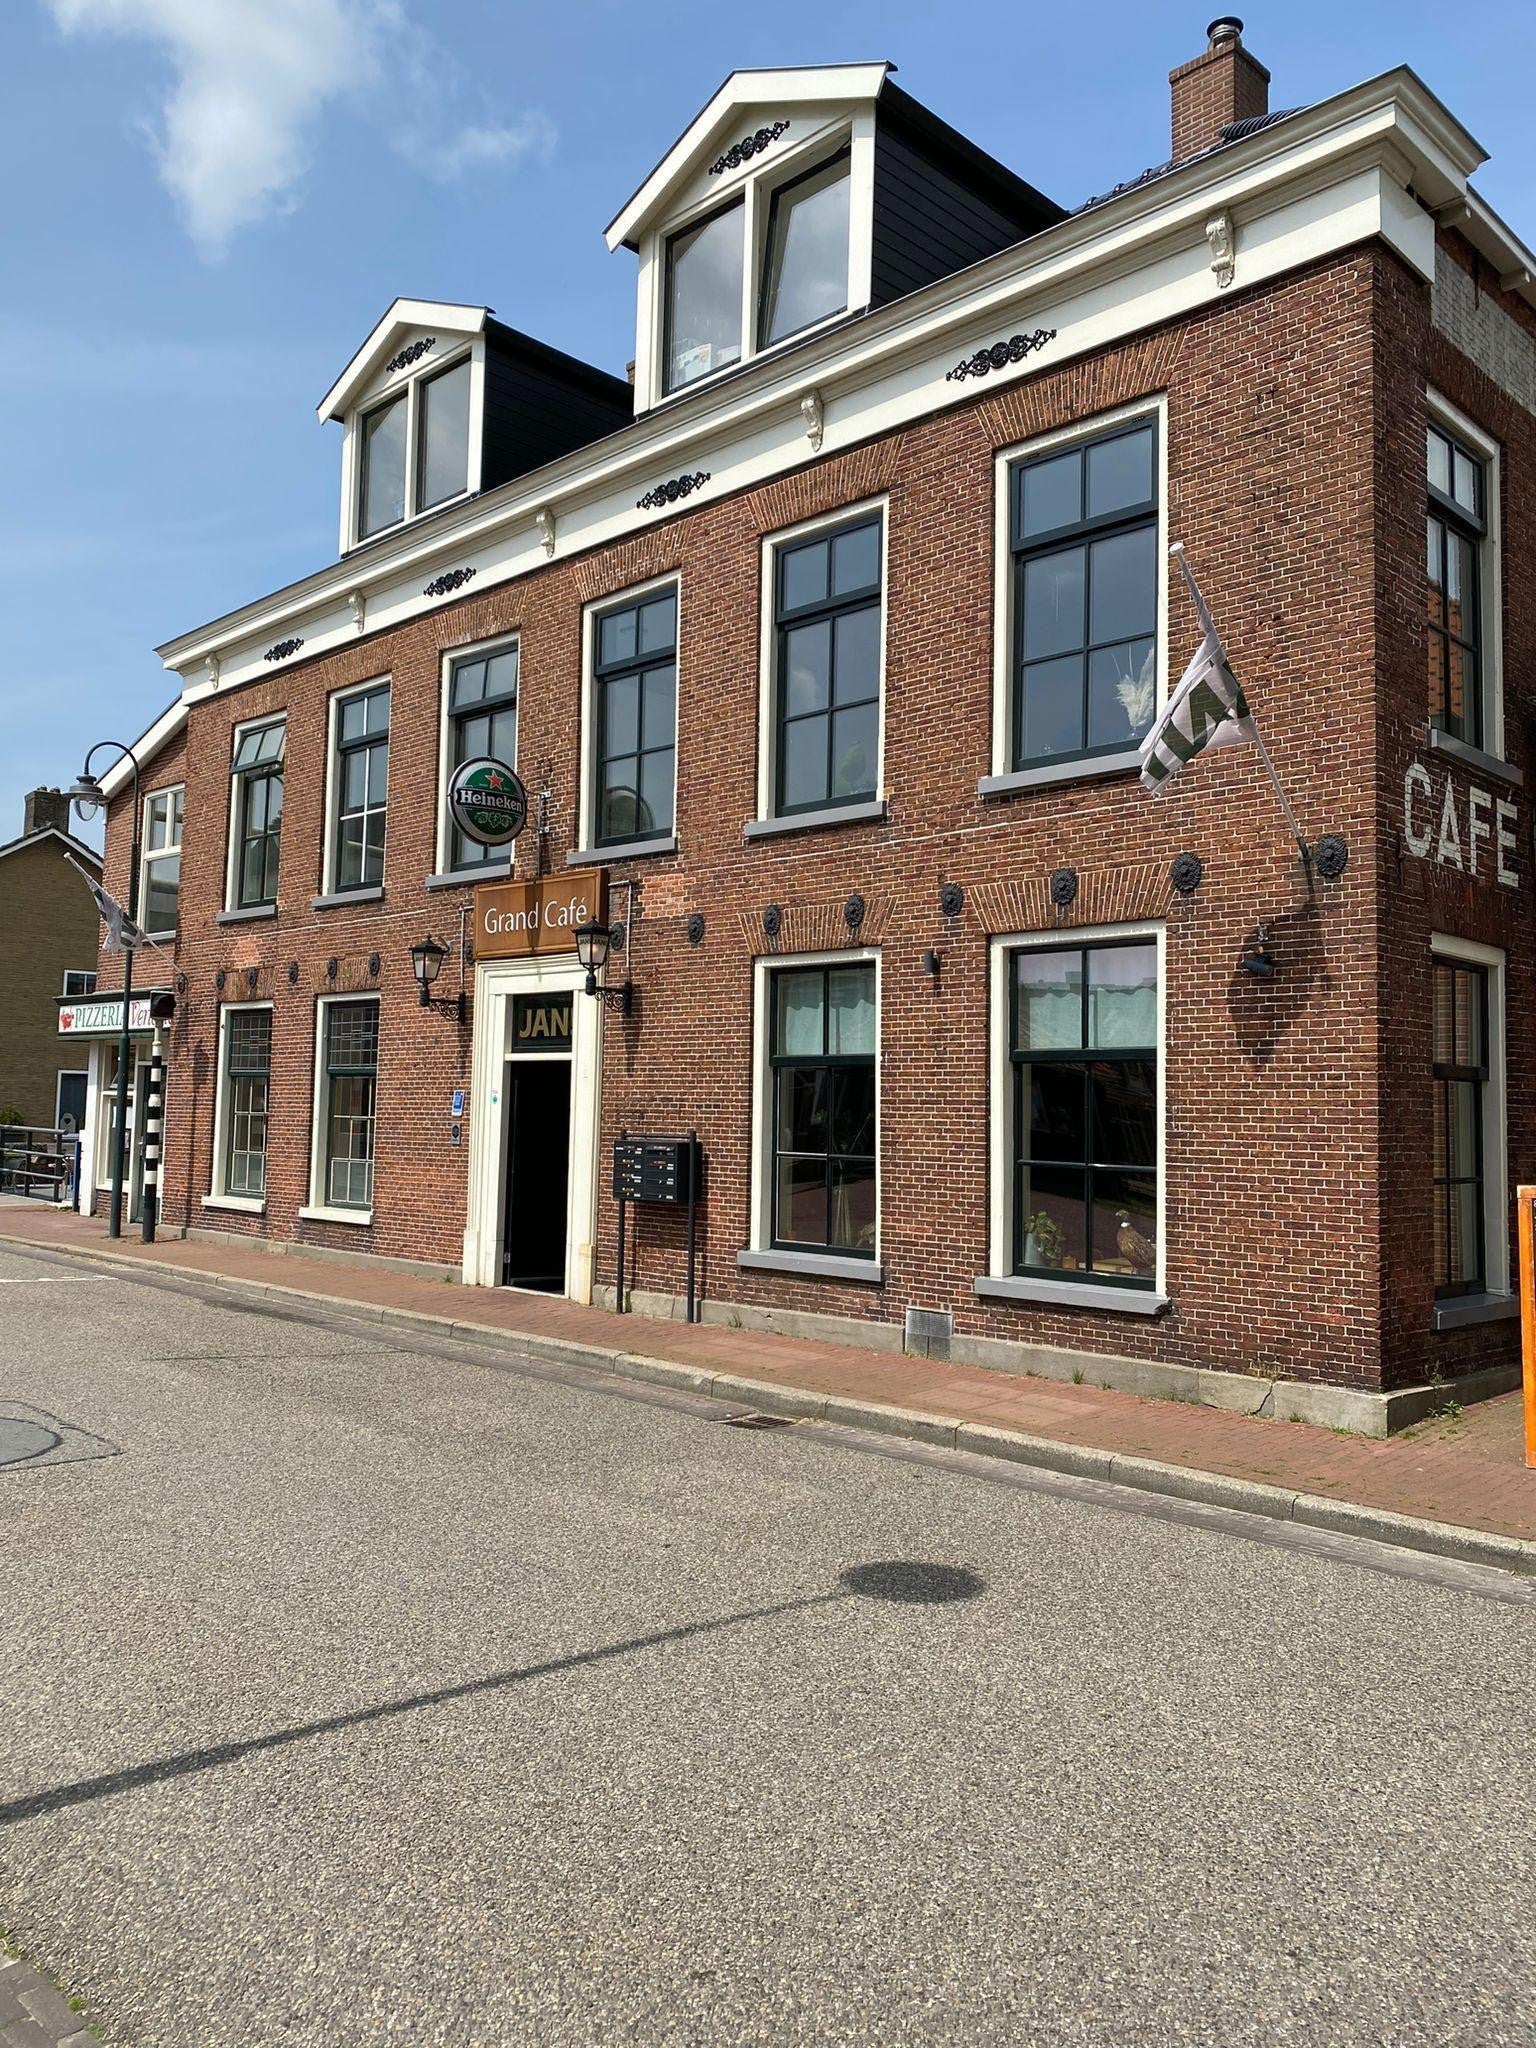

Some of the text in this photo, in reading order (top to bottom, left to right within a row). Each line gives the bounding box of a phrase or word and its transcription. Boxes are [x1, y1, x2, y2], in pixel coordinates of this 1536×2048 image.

[460, 789, 522, 812] Heineken
[484, 896, 588, 934] Grand Café
[519, 1007, 573, 1038] JAN
